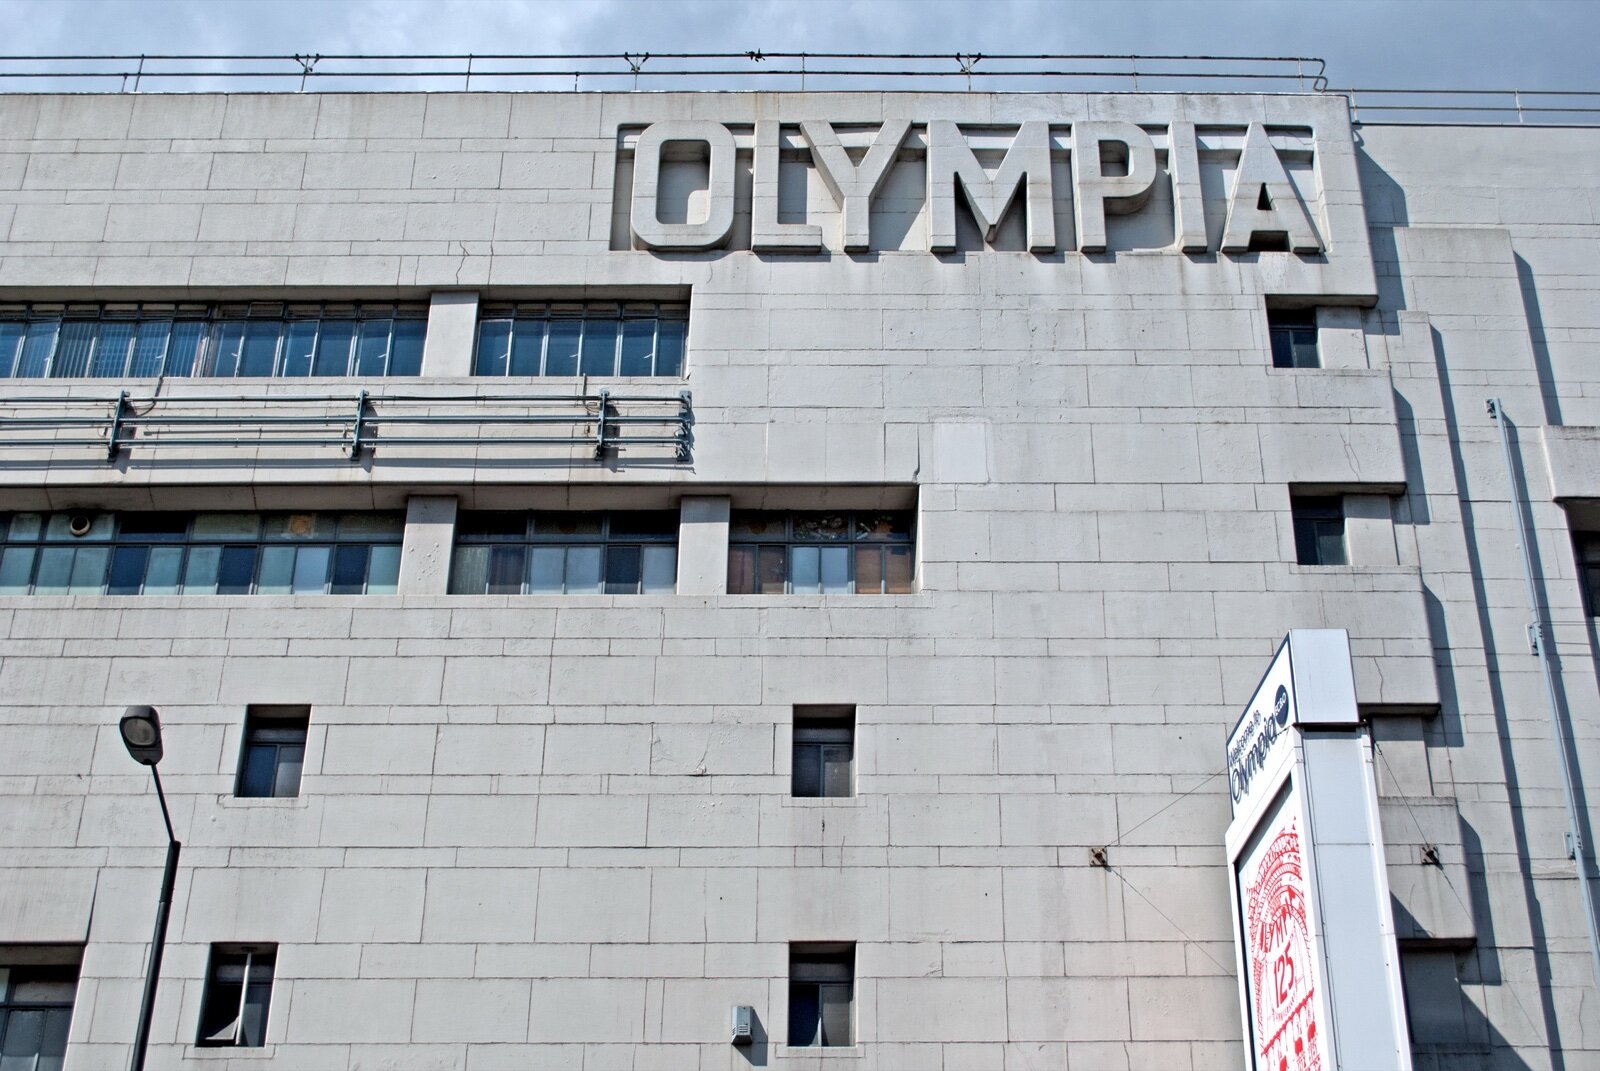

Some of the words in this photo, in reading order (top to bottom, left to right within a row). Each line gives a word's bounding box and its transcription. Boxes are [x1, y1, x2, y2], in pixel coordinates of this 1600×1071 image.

[630, 121, 1324, 252] OLYMPIA
[1232, 714, 1276, 803] Olympia
[1274, 940, 1294, 1008] 125
